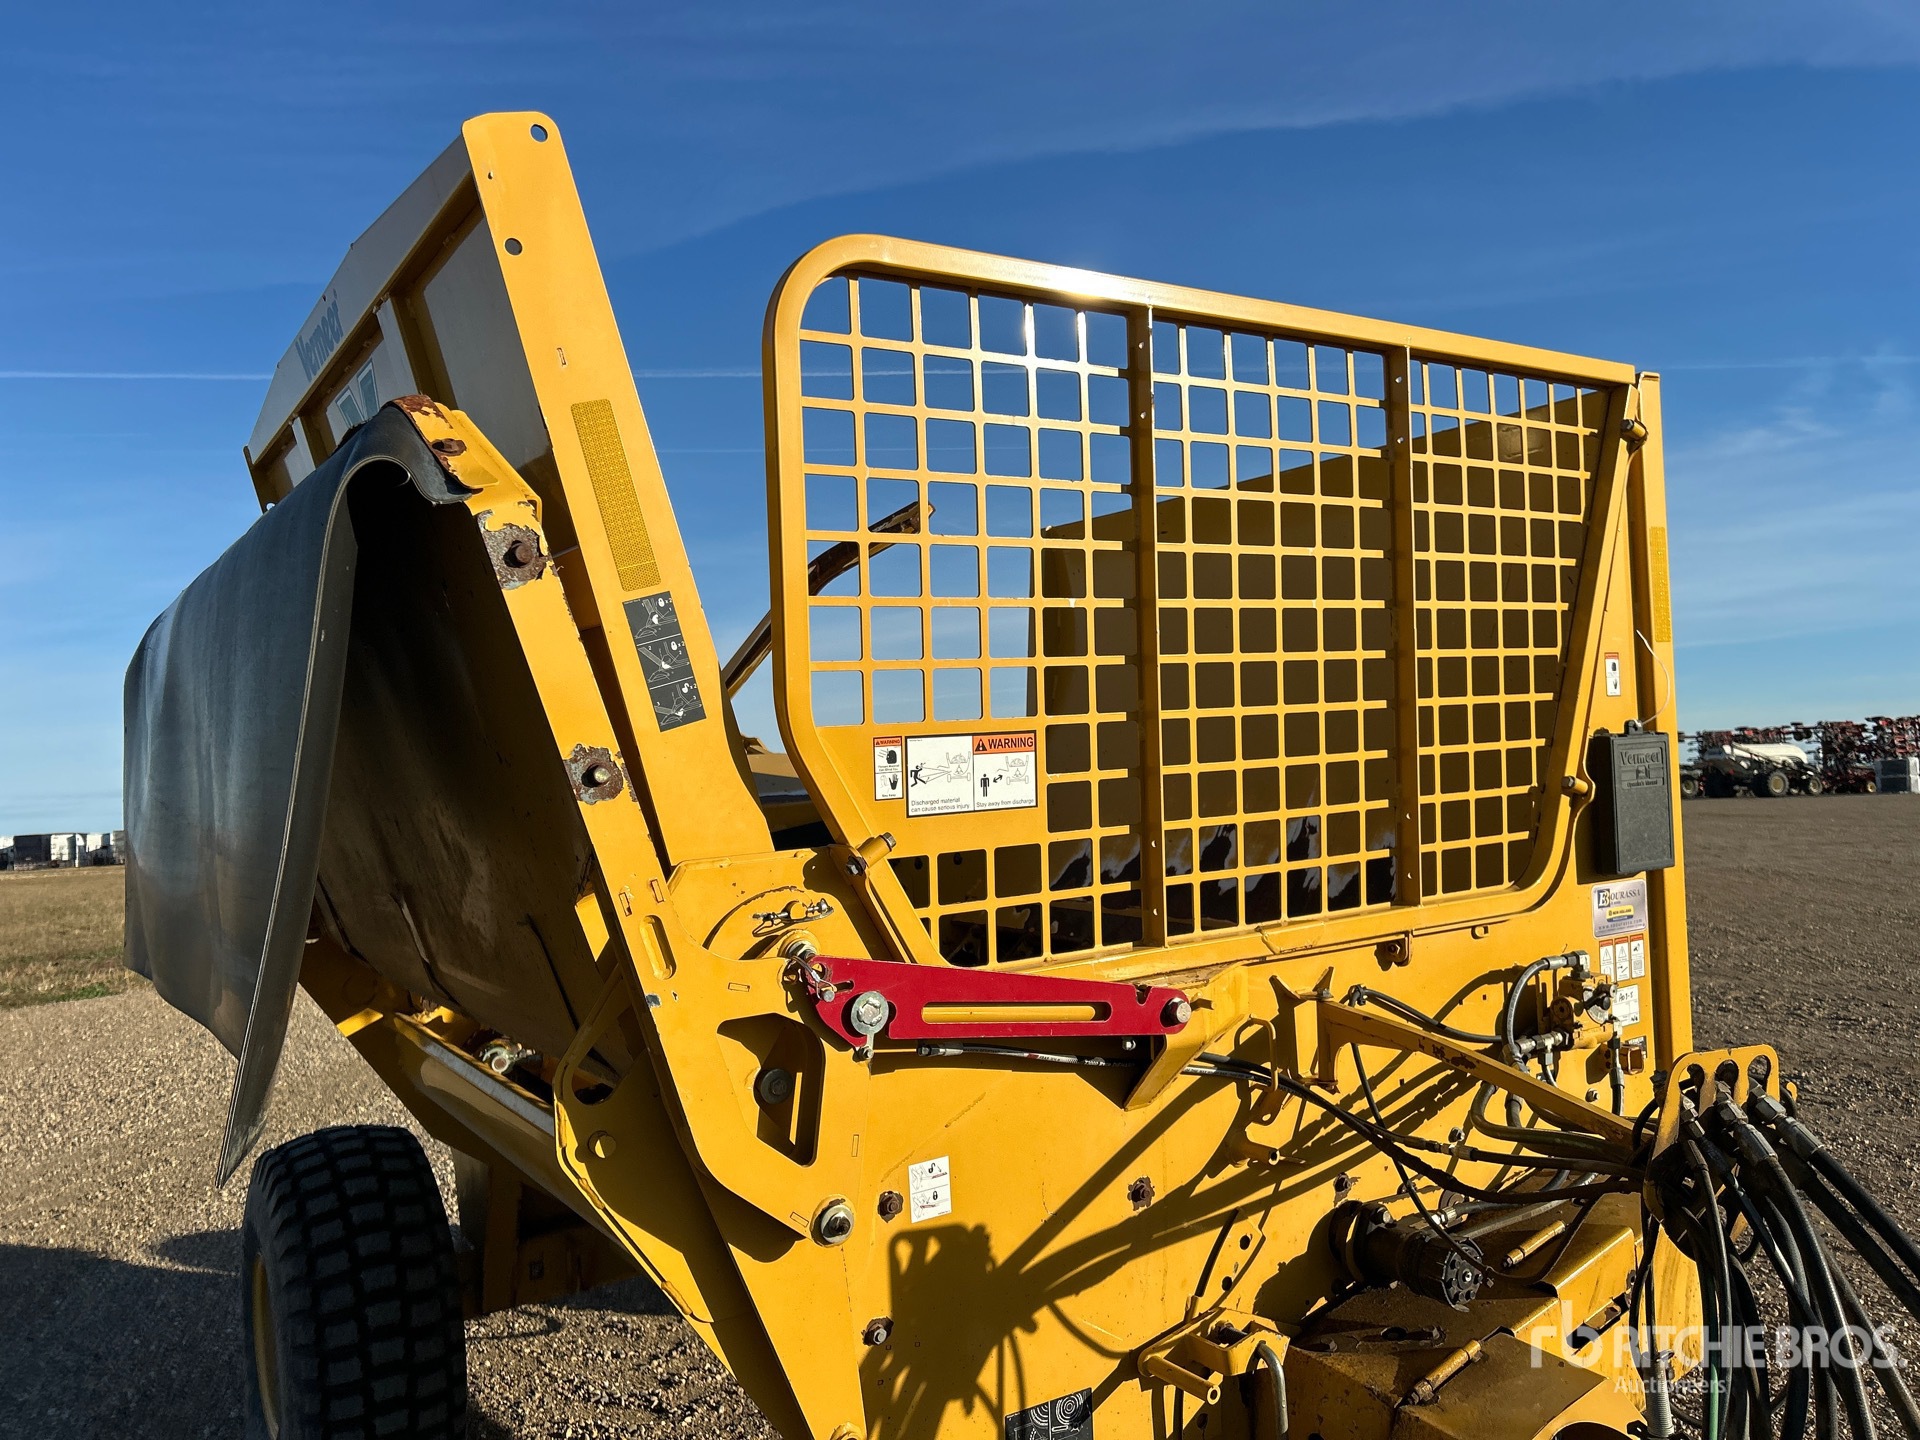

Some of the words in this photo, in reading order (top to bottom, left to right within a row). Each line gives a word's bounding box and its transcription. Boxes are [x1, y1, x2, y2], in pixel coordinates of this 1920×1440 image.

[988, 737, 1033, 749] WARNING
[1620, 751, 1661, 766] Vermeer
[911, 798, 940, 806] Discharged
